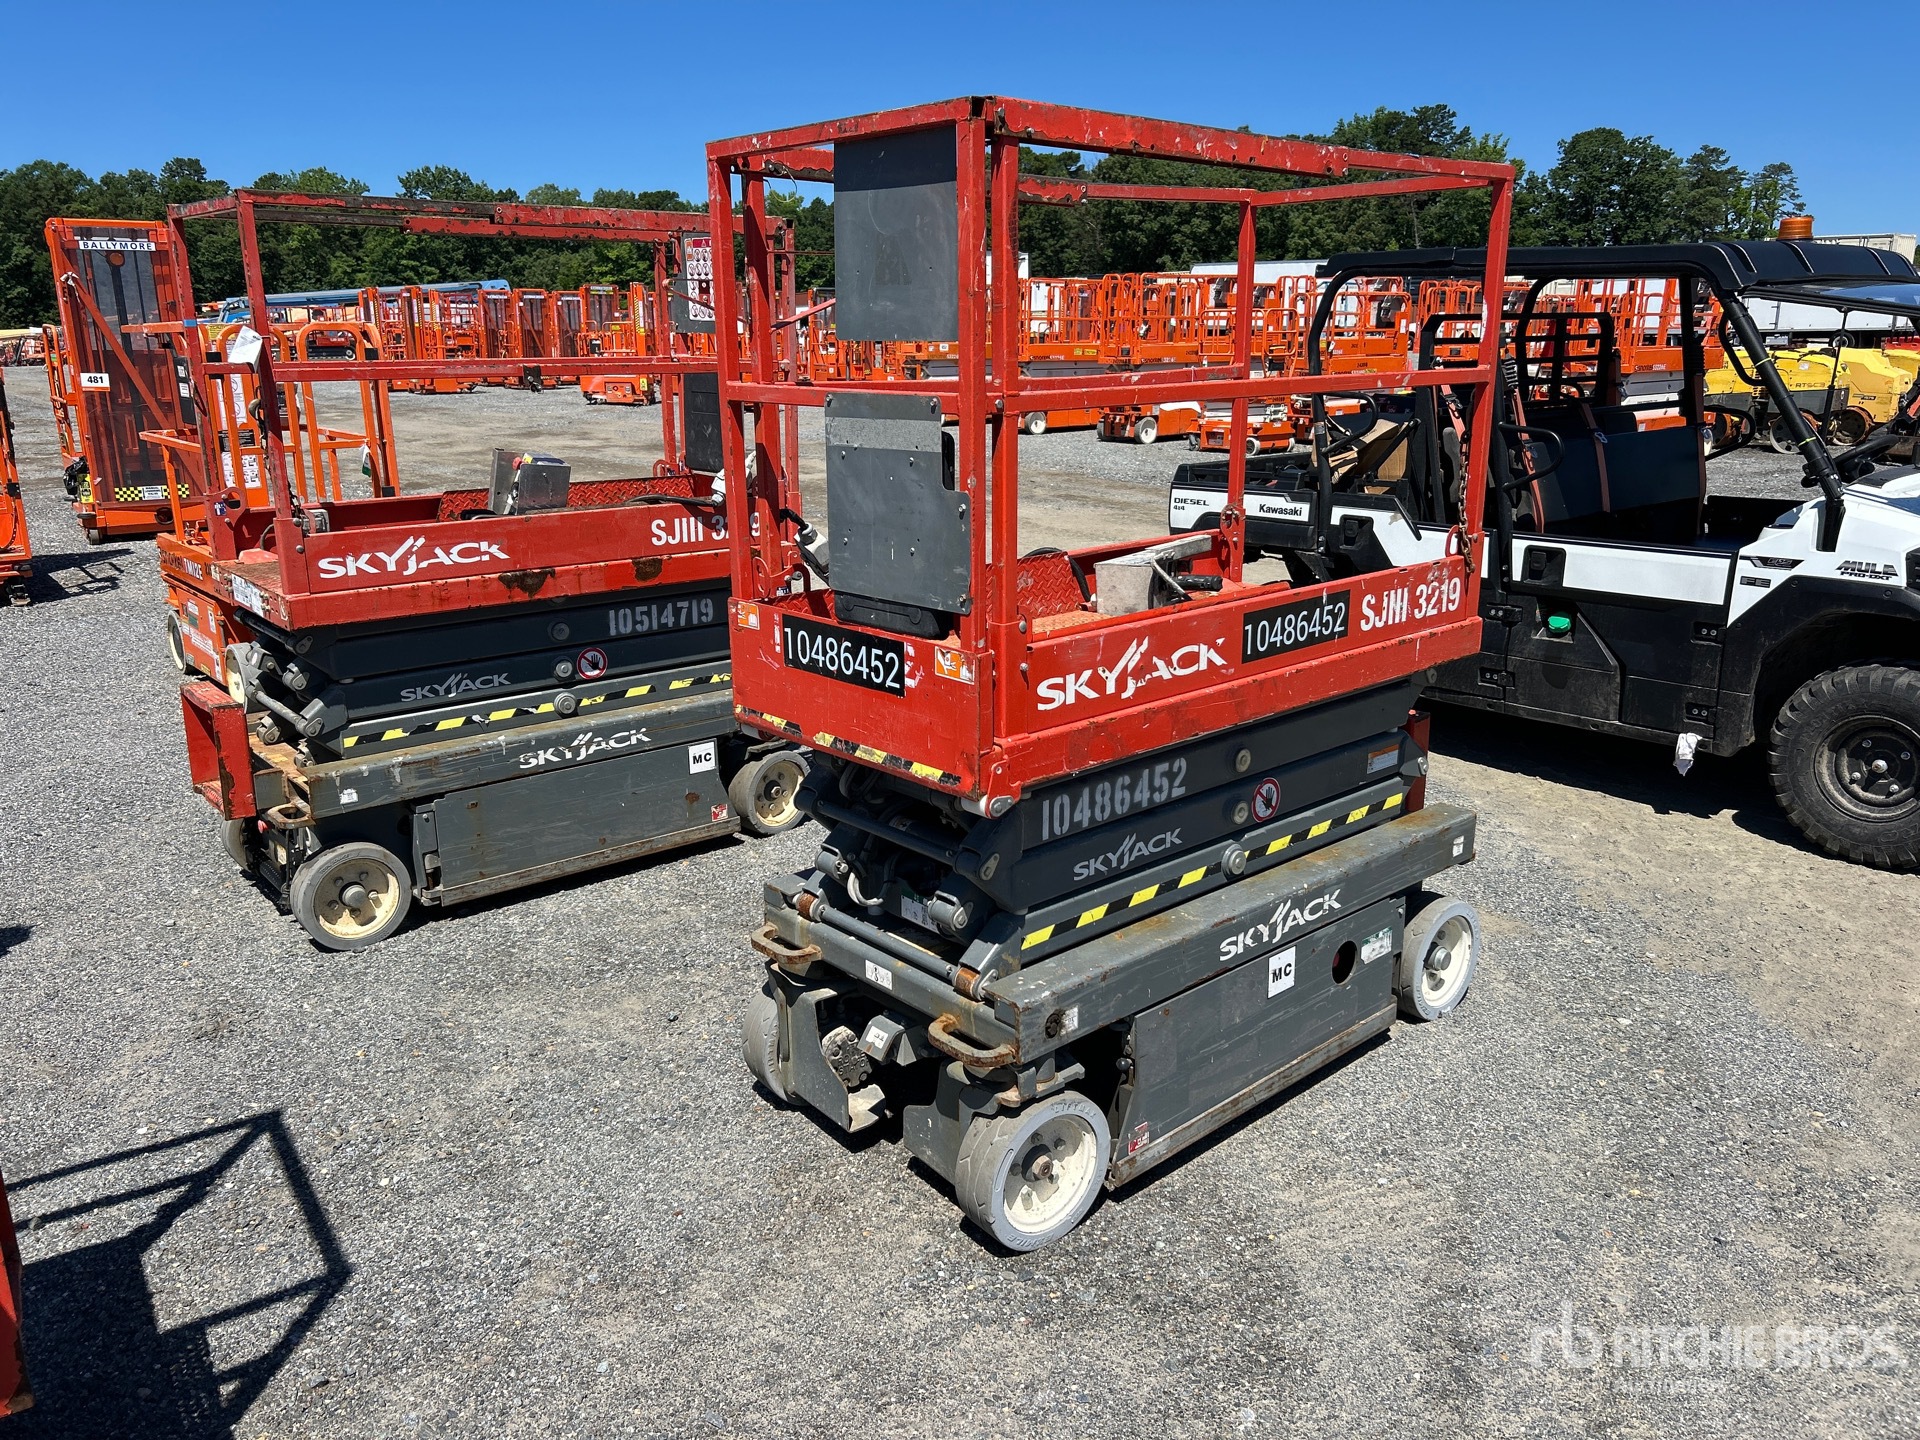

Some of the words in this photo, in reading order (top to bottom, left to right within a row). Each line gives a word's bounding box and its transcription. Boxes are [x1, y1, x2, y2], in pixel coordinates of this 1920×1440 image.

[83, 241, 153, 251] BALLYMORE
[87, 375, 104, 384] 481
[1173, 497, 1210, 507] DIESEL
[1259, 504, 1303, 517] Kawasaki
[317, 535, 511, 579] SKYJACK
[1840, 571, 1893, 581] PRO-DXT
[1413, 578, 1461, 620] 3219
[609, 598, 714, 636] 10514719
[1244, 600, 1347, 655] 10486452
[784, 627, 901, 689] 10486452
[400, 672, 512, 702] SKYJACK
[692, 752, 712, 765] MC
[1041, 757, 1187, 841] 10486452
[1072, 827, 1183, 881] SKYJACK
[1219, 888, 1342, 961] SKYJACK
[1271, 962, 1293, 984] MC
